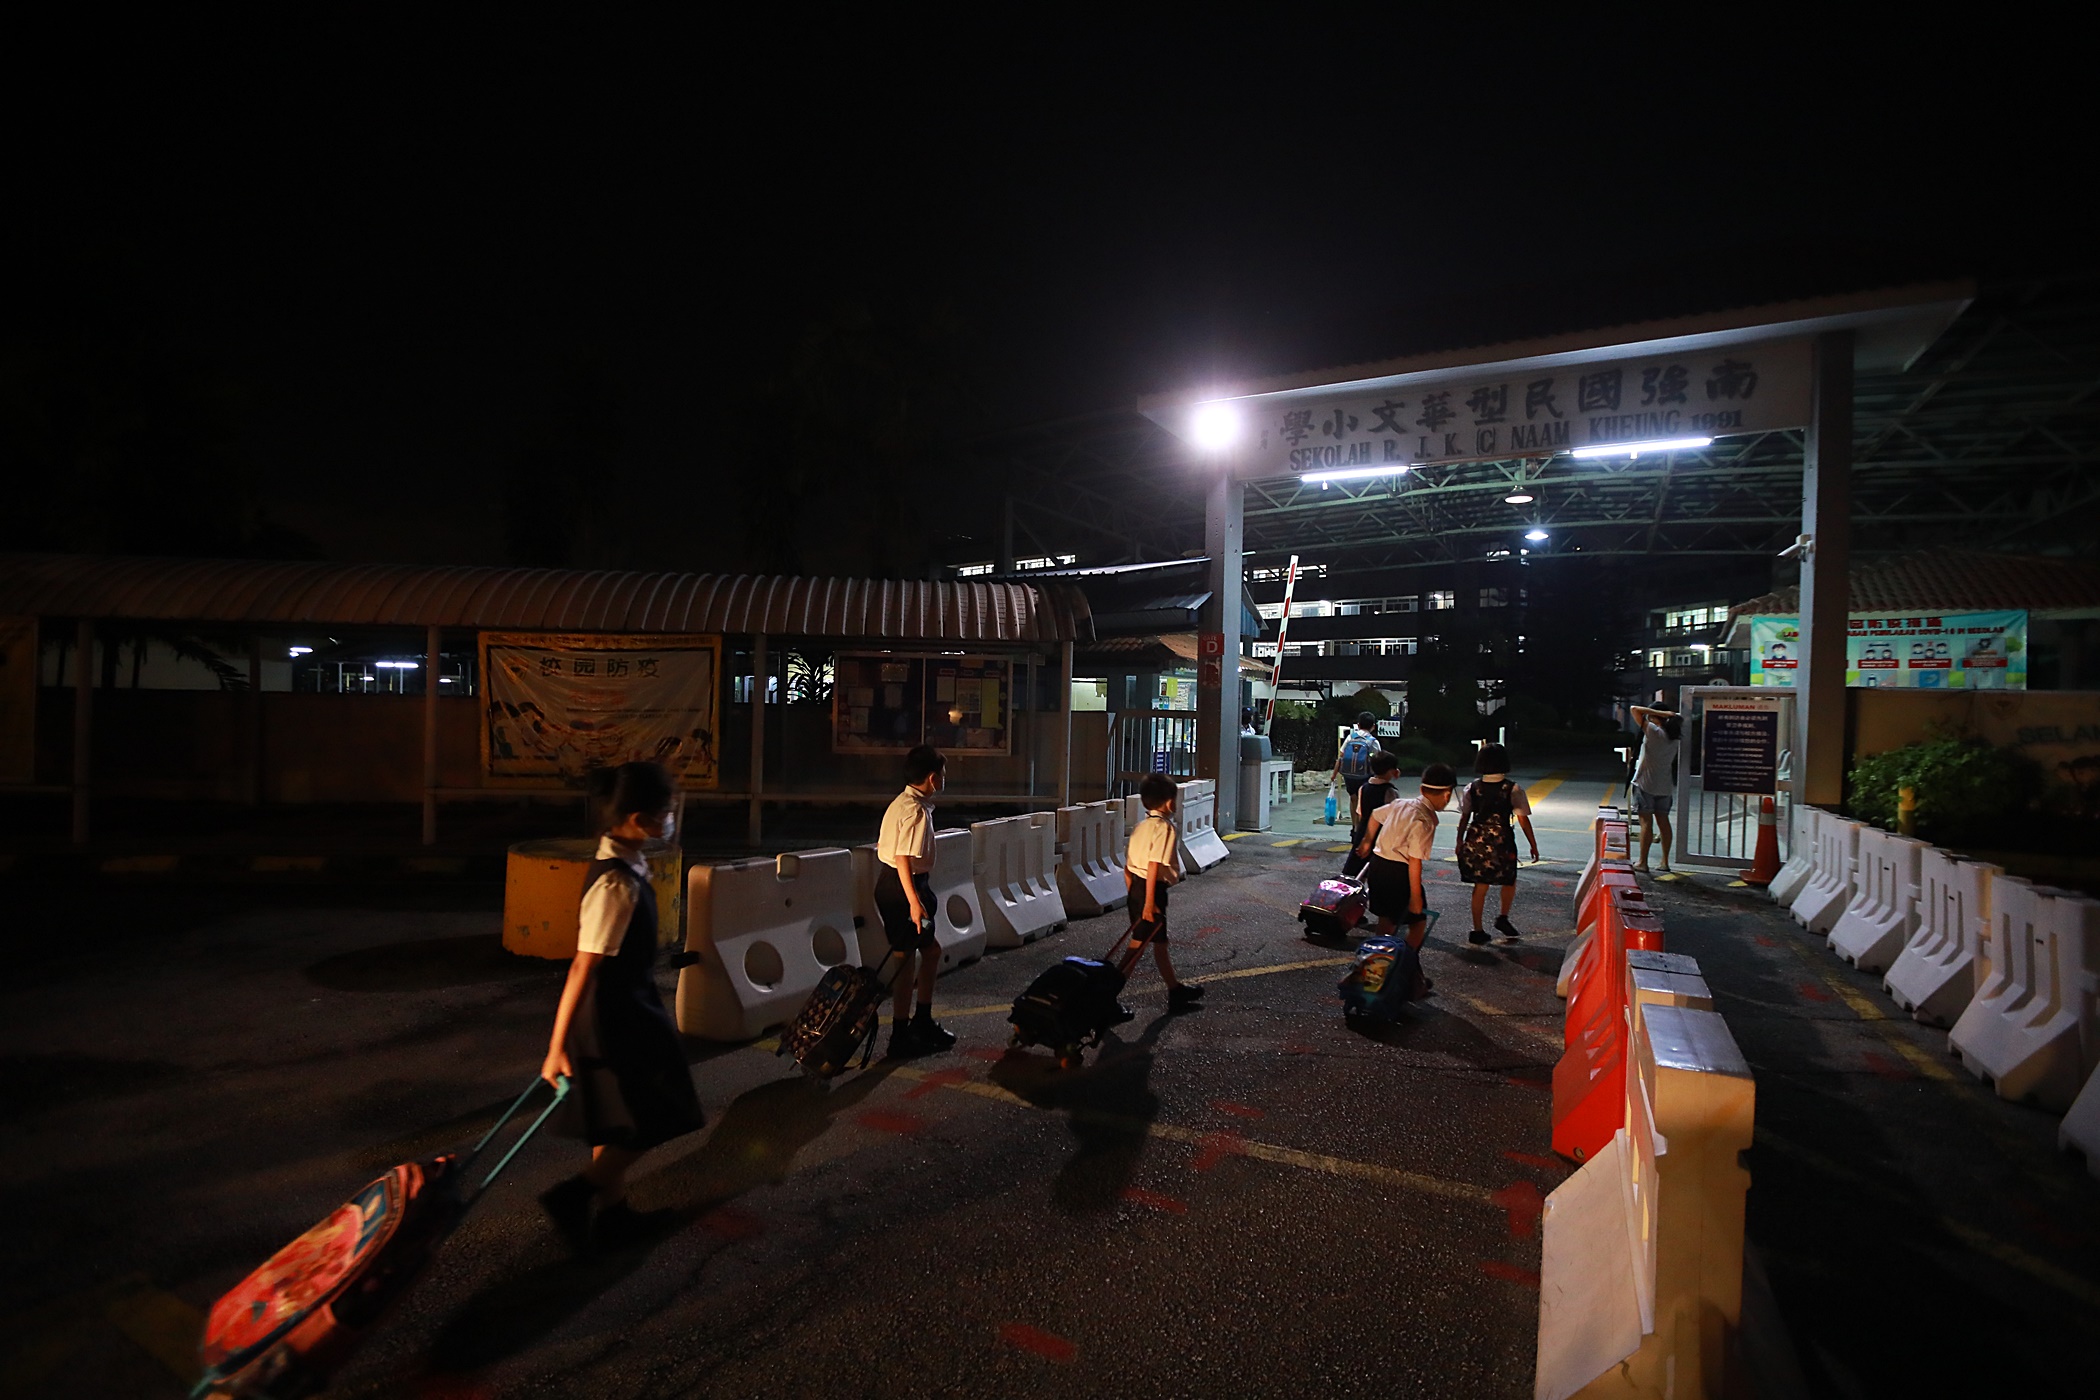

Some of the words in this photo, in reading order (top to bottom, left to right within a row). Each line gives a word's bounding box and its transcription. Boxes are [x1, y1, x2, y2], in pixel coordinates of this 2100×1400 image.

[1289, 441, 1372, 471] SEKOLAH
[1383, 439, 1401, 462] R.
[1414, 436, 1431, 459] J.
[1444, 432, 1463, 456] K.
[1510, 420, 1571, 450] NAAM
[1587, 410, 1681, 442] KHEUNG
[1690, 409, 1743, 432] 1991
[1206, 641, 1218, 653] D
[539, 656, 660, 679] 校园防疫
